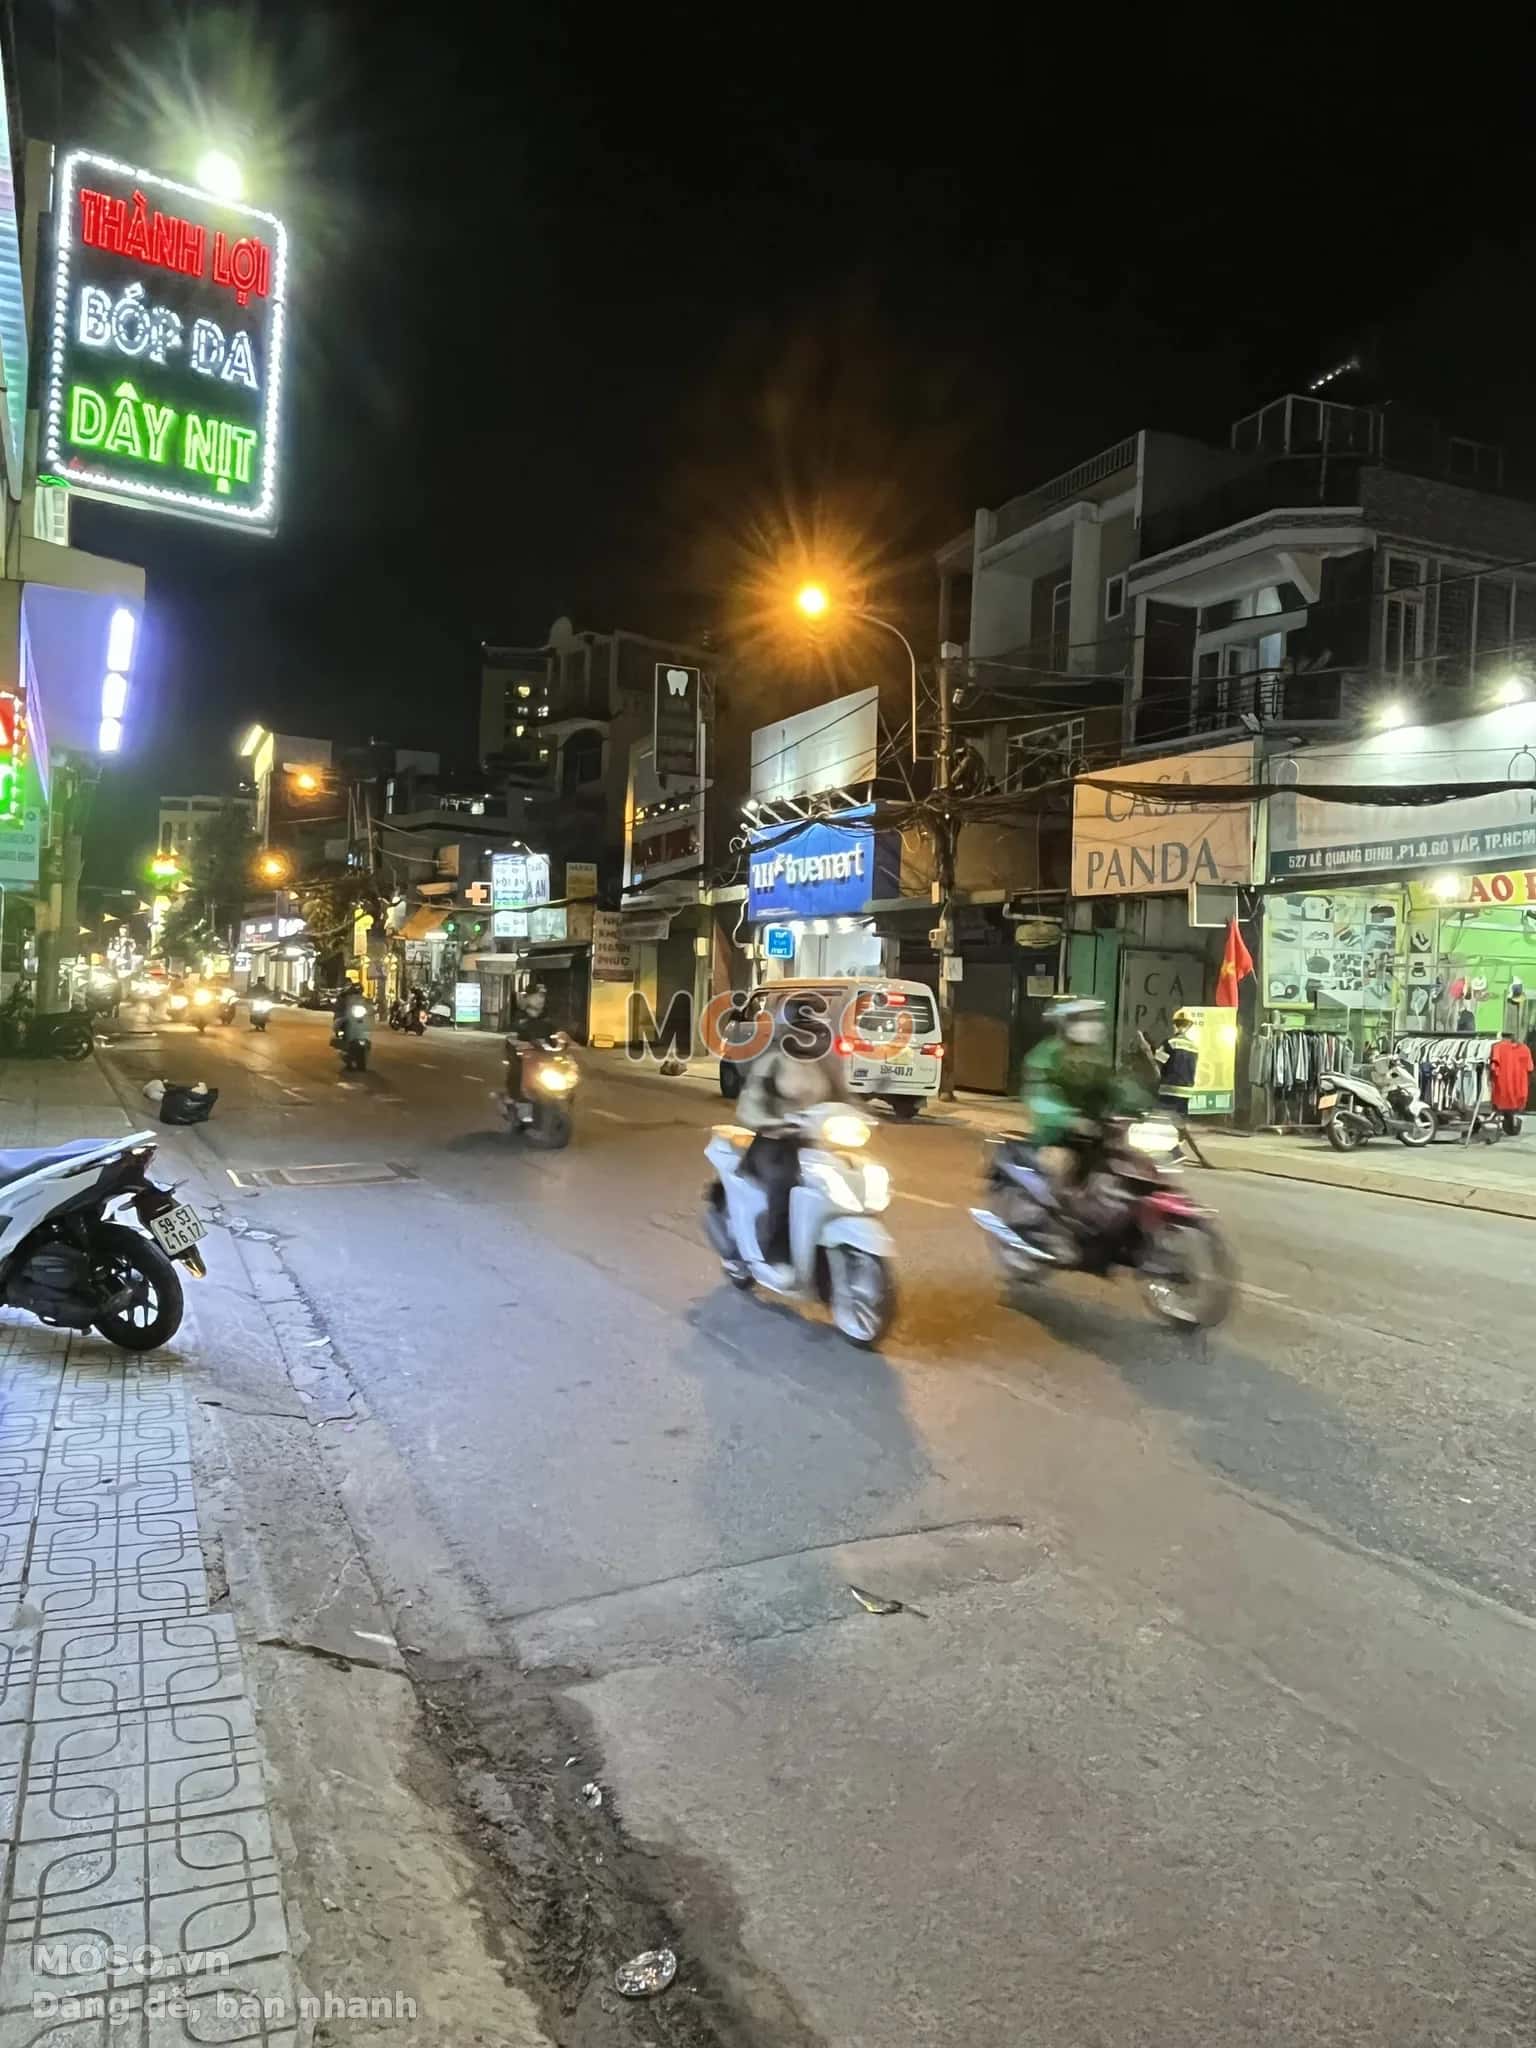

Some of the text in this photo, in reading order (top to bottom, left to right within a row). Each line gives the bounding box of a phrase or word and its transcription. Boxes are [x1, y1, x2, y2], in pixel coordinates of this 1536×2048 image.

[80, 189, 272, 304] THÀNH LỢI
[79, 281, 259, 390] BÓP DA
[70, 381, 258, 494] DÂY NỊT
[1087, 837, 1220, 889] PANDA
[1288, 855, 1307, 869] 527
[1325, 847, 1362, 868] QUANG
[1484, 829, 1536, 850] TP.HCM
